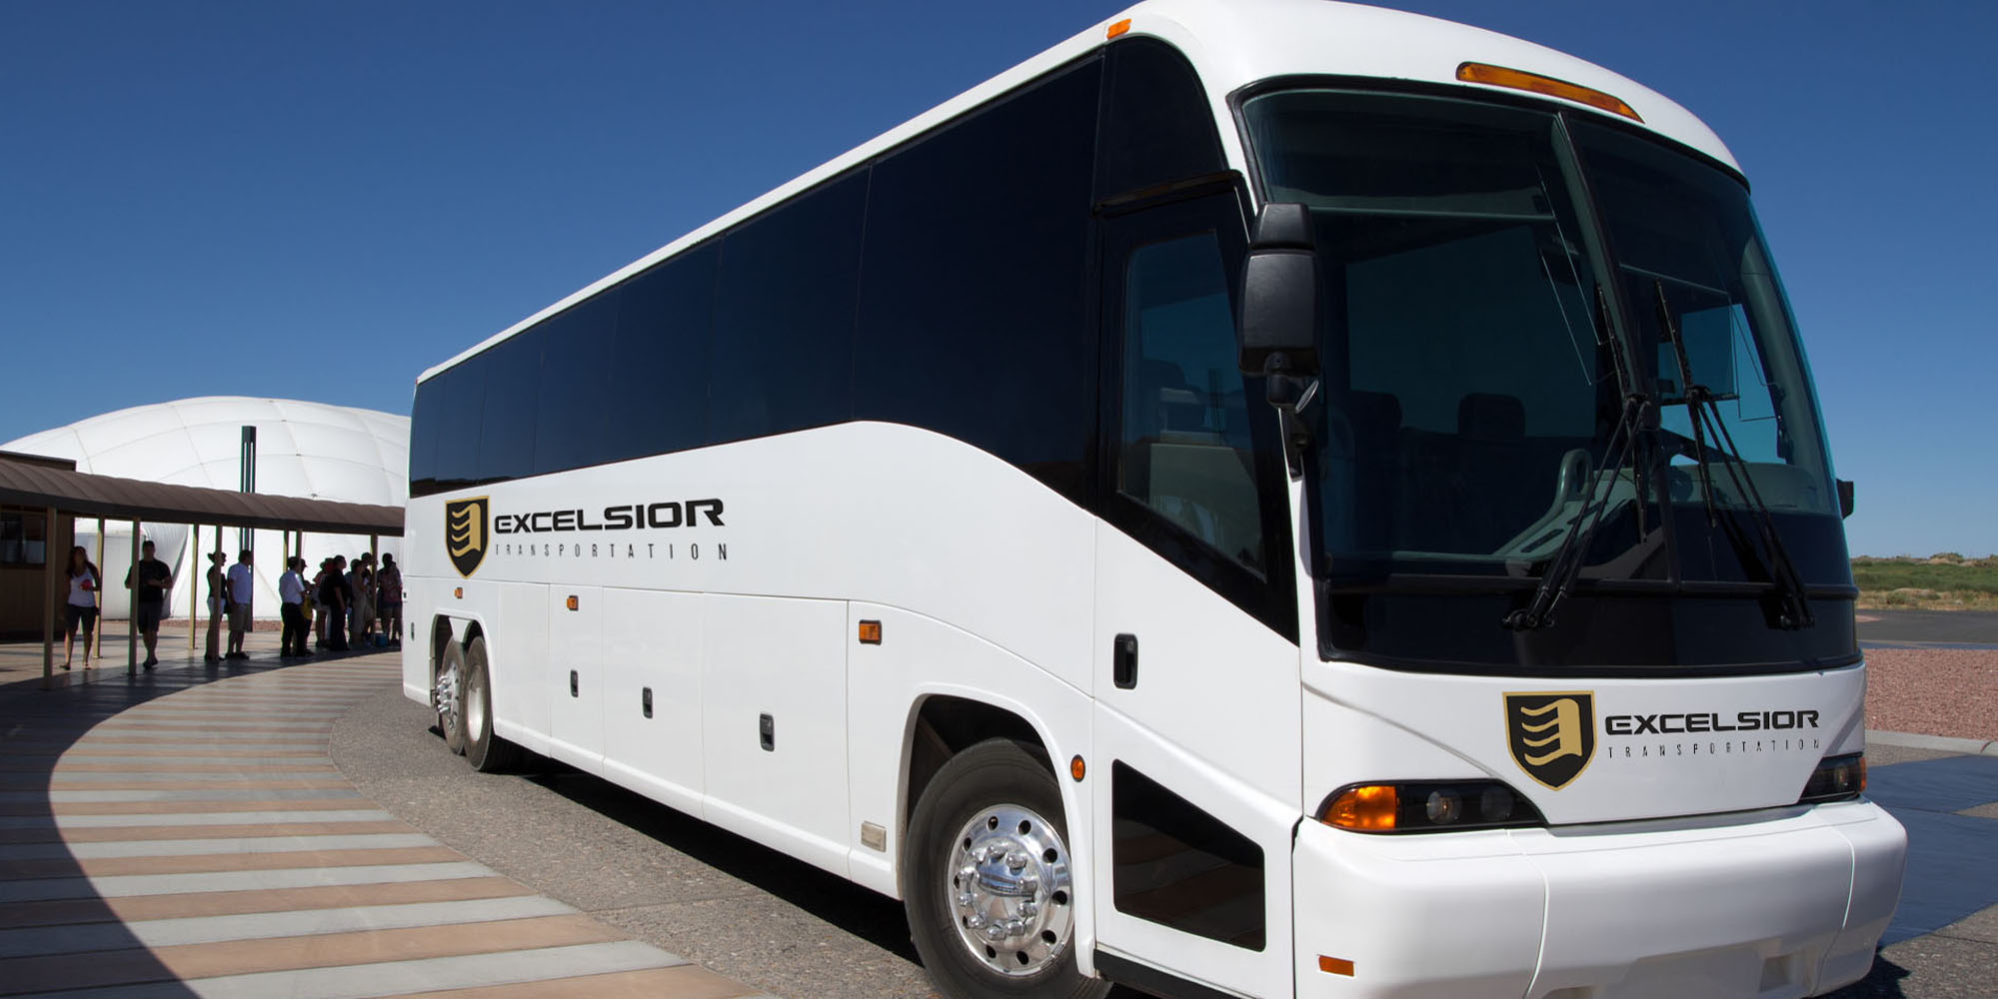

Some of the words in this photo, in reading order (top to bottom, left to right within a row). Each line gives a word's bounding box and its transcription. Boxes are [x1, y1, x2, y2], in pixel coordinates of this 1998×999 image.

[494, 498, 725, 534] EXCELSIOR
[495, 543, 727, 560] TRANSPORTATION
[1604, 710, 1819, 735] EXCELSIOR
[1608, 739, 1820, 759] TRANSPORTATION
